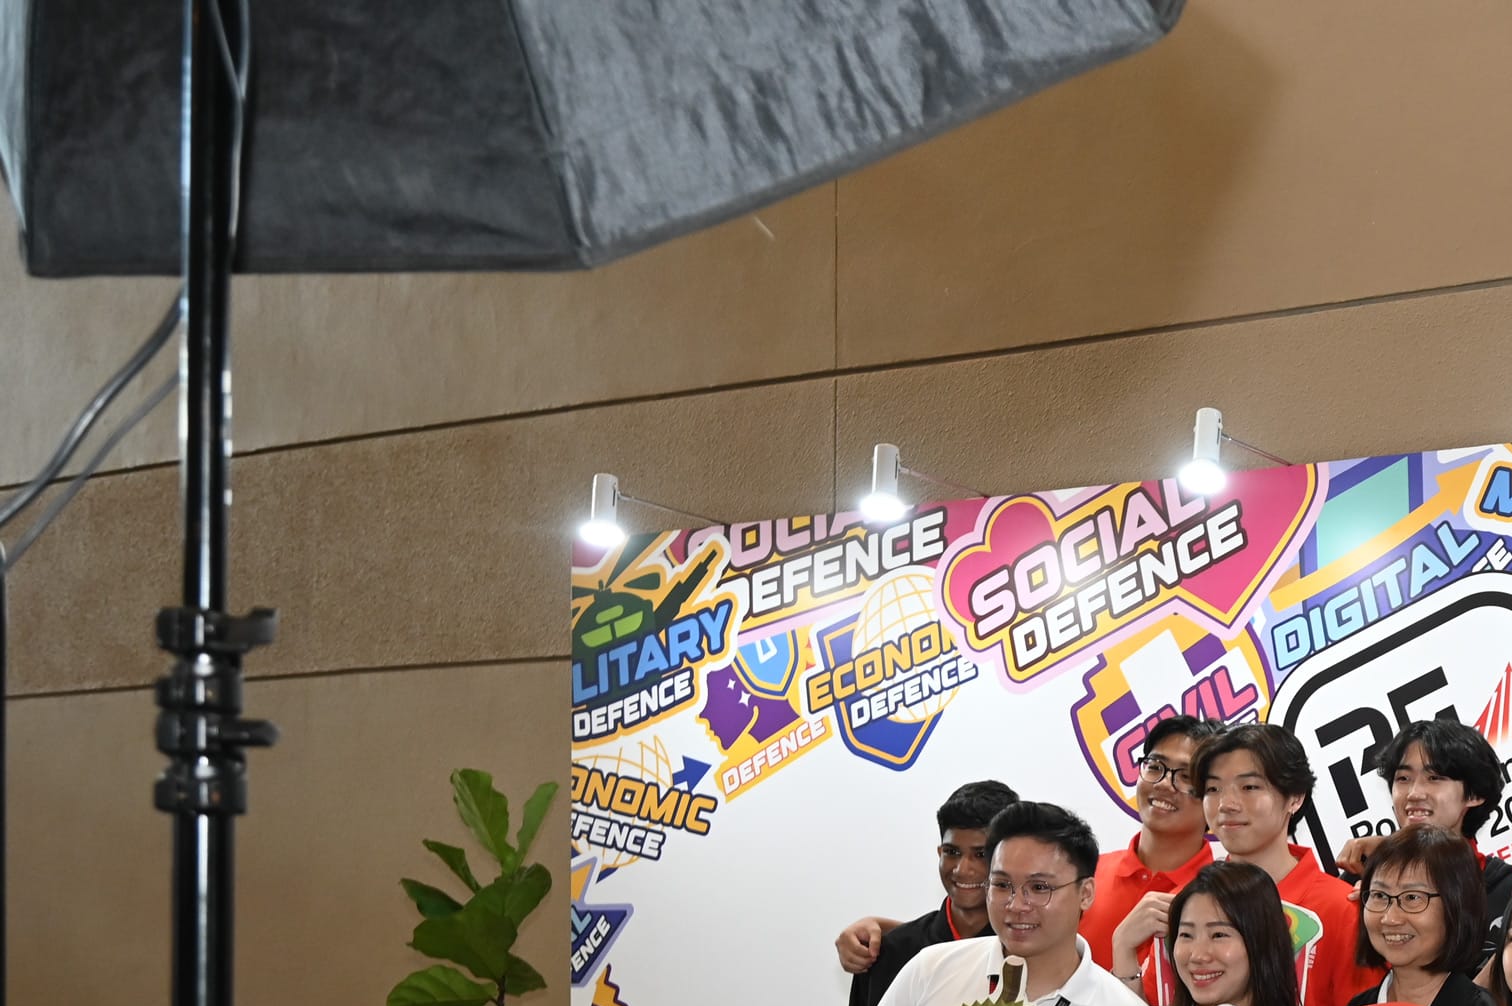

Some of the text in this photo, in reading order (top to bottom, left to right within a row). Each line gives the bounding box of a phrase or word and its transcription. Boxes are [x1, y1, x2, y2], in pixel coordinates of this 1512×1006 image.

[971, 477, 1207, 637] SOCIAL
[1012, 504, 1245, 670] DEFENCE
[1273, 522, 1479, 670] DIGITAL
[573, 670, 692, 738] DEFENCE
[806, 620, 958, 714] ECONO
[850, 656, 978, 730] DEFENCE
[721, 717, 827, 797] DEFENCE
[571, 813, 666, 860] FENCE
[571, 914, 612, 973] ENCE
